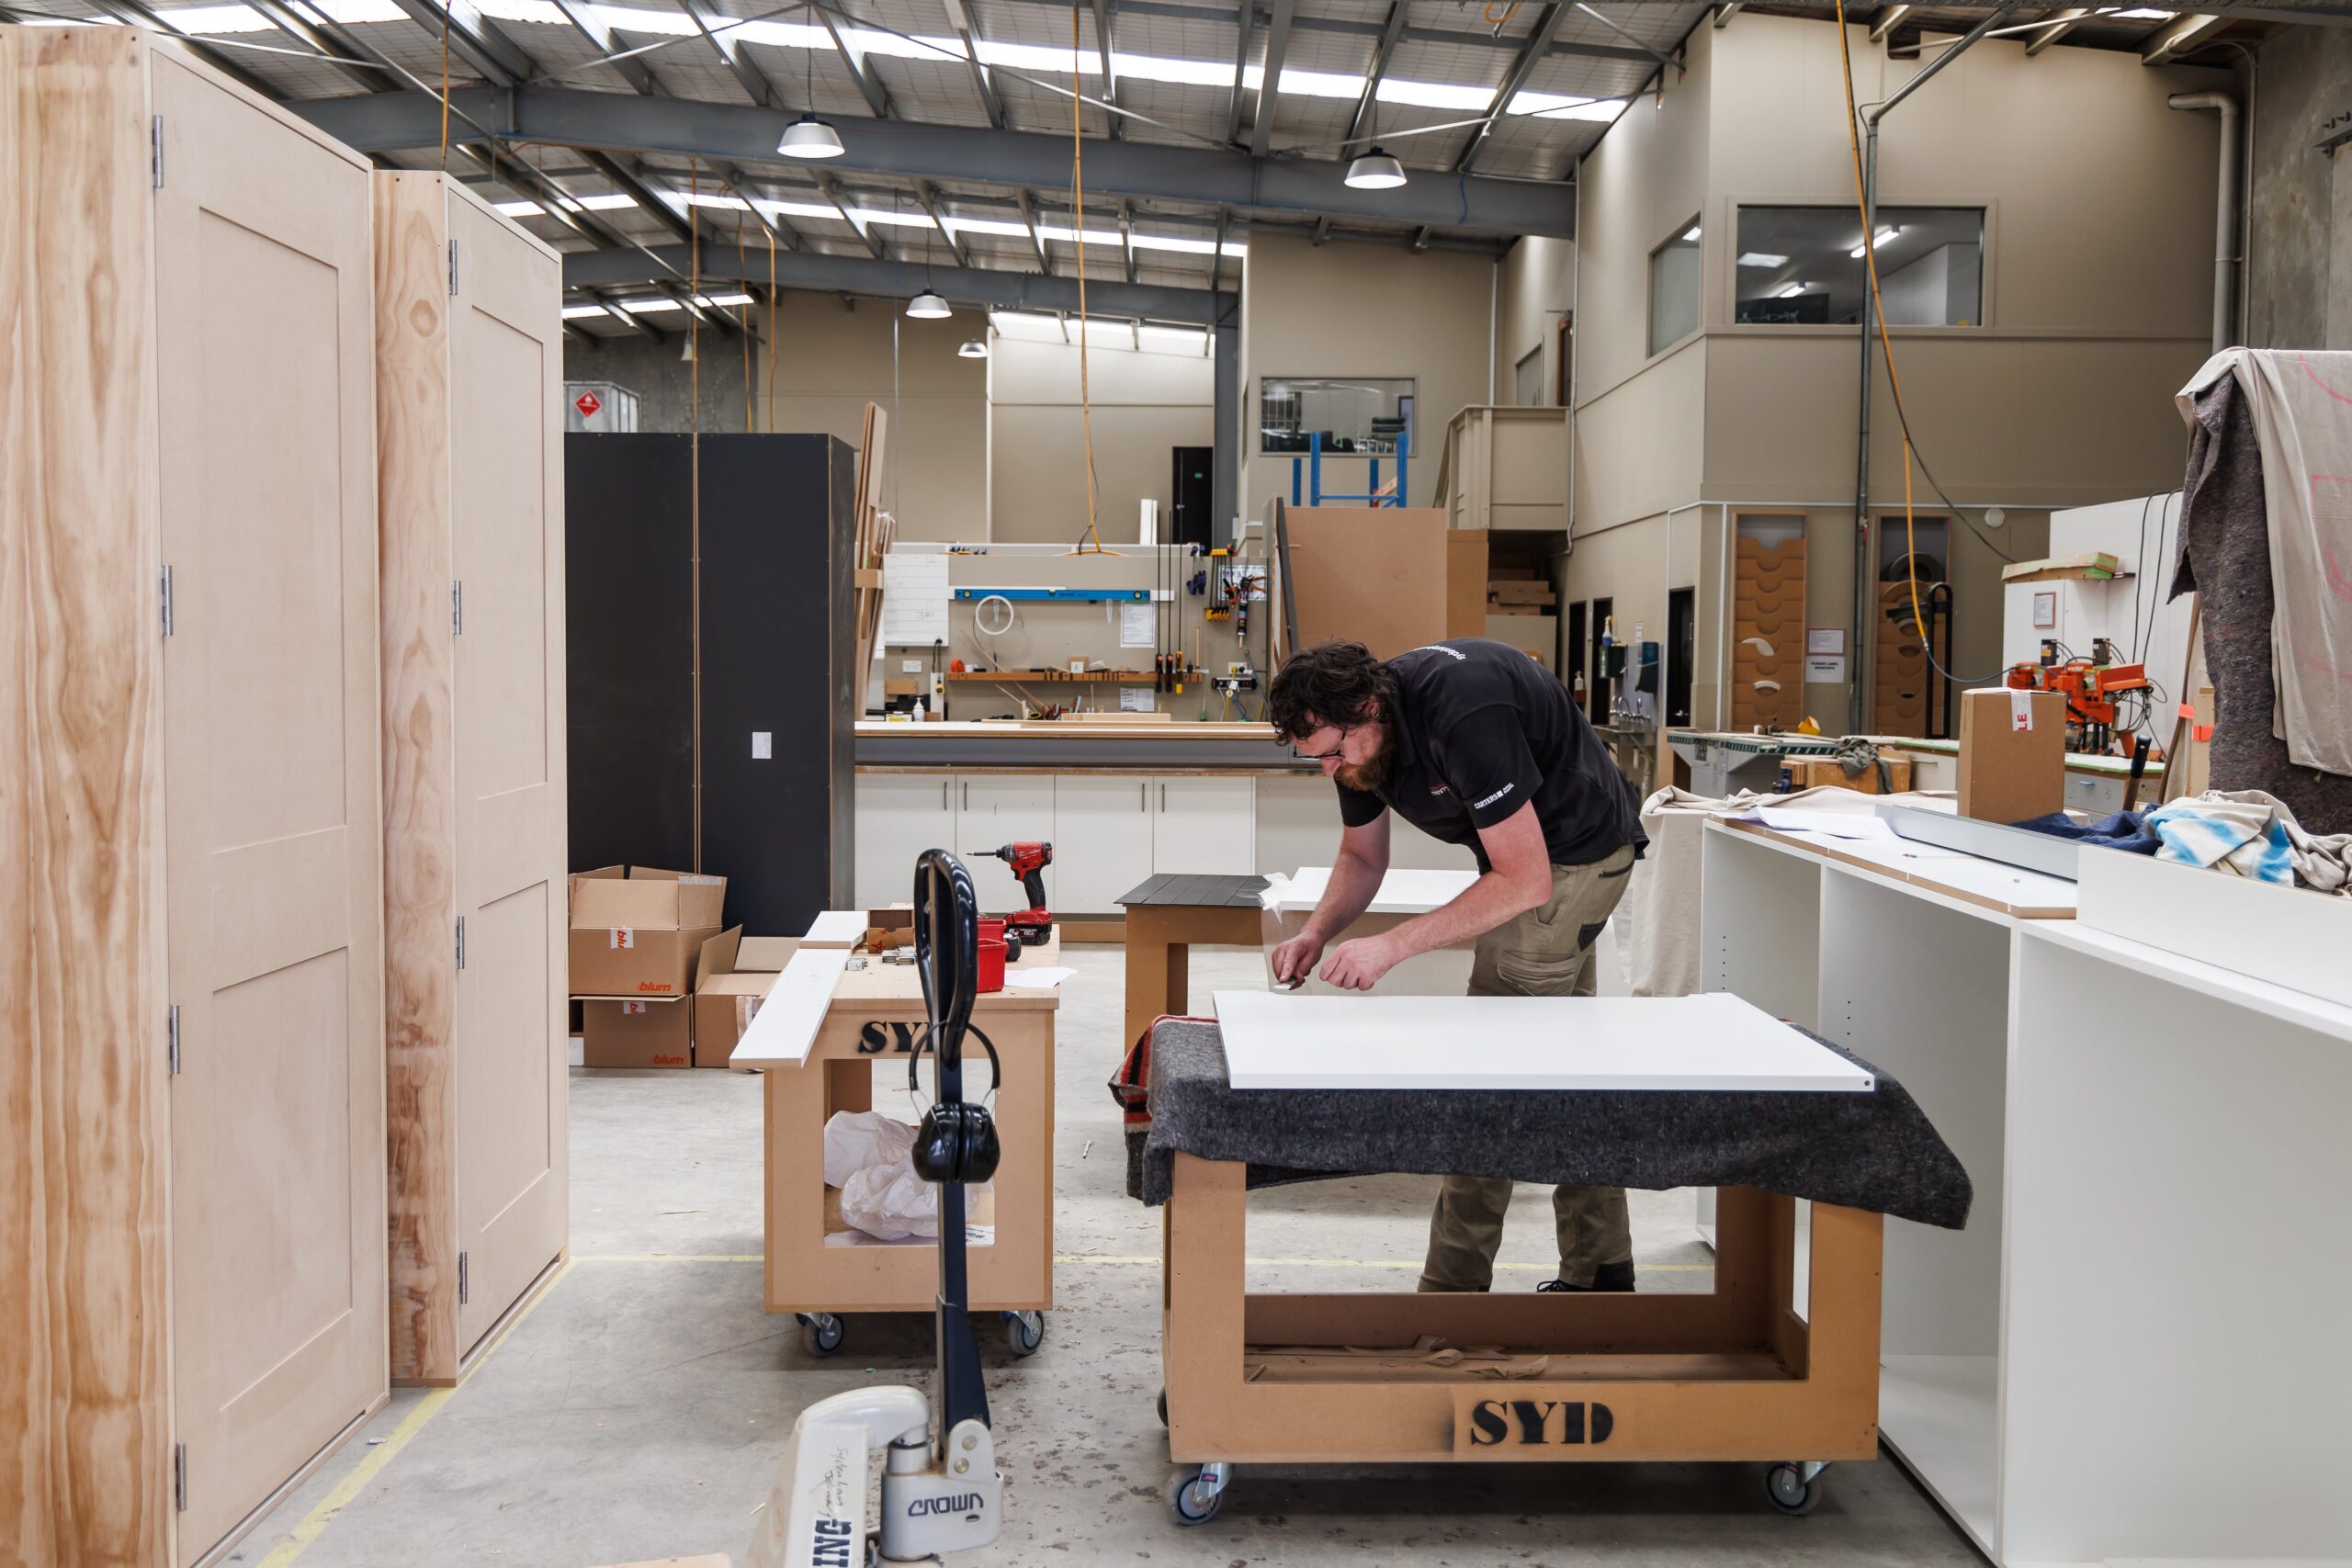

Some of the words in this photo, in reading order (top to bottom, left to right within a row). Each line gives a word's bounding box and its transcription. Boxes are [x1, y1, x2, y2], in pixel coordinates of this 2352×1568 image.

[1474, 793, 1498, 809] CARTERS
[639, 981, 672, 992] blum
[858, 1021, 935, 1055] SY
[652, 1055, 684, 1065] blum
[1470, 1400, 1614, 1446] SYD
[811, 1518, 853, 1568] ING
